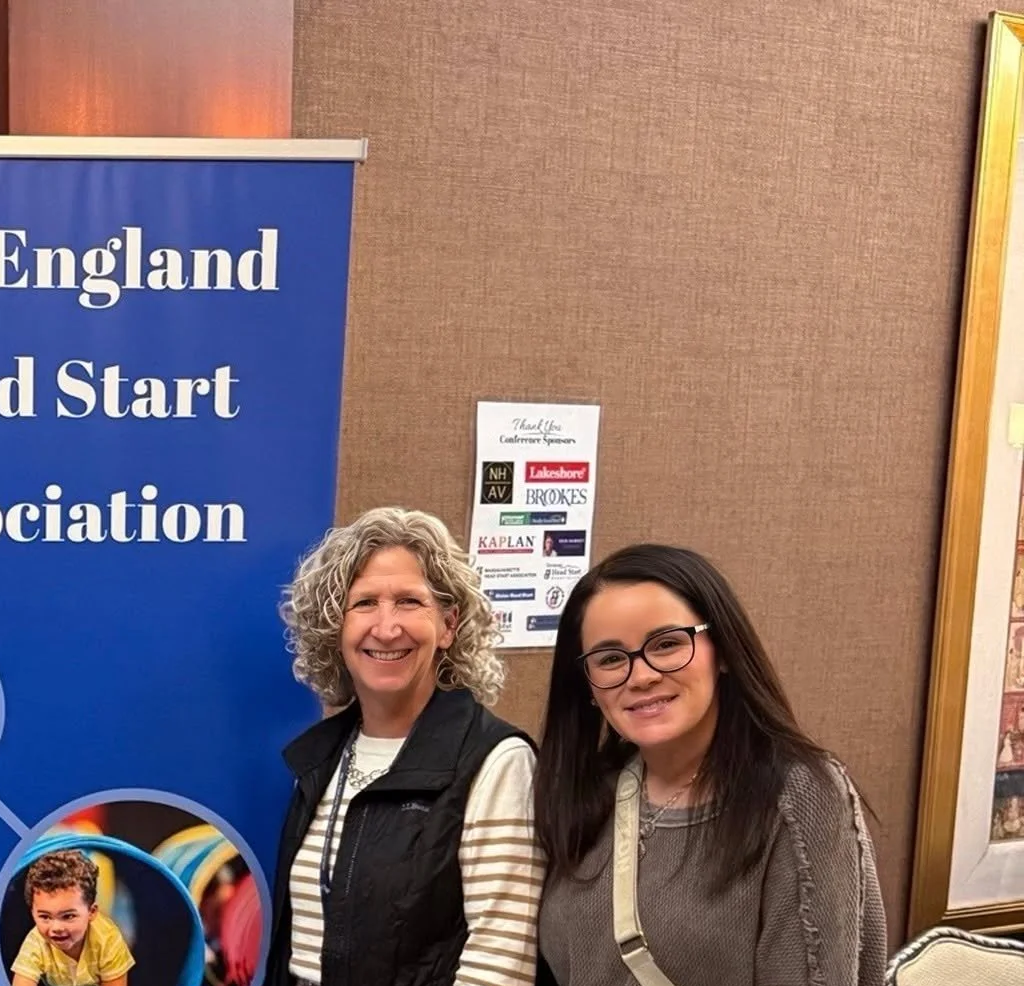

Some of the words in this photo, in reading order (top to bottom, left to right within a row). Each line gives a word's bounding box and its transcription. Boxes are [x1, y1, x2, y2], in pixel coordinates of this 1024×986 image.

[56, 359, 240, 418] Start
[512, 418, 544, 434] Thank
[543, 419, 562, 434] You
[499, 435, 541, 444] Conference
[543, 435, 576, 446] Sponsors
[489, 467, 507, 480] NH
[488, 486, 507, 498] AV
[525, 488, 588, 506] BROOKES
[478, 536, 534, 548] KAPLAN
